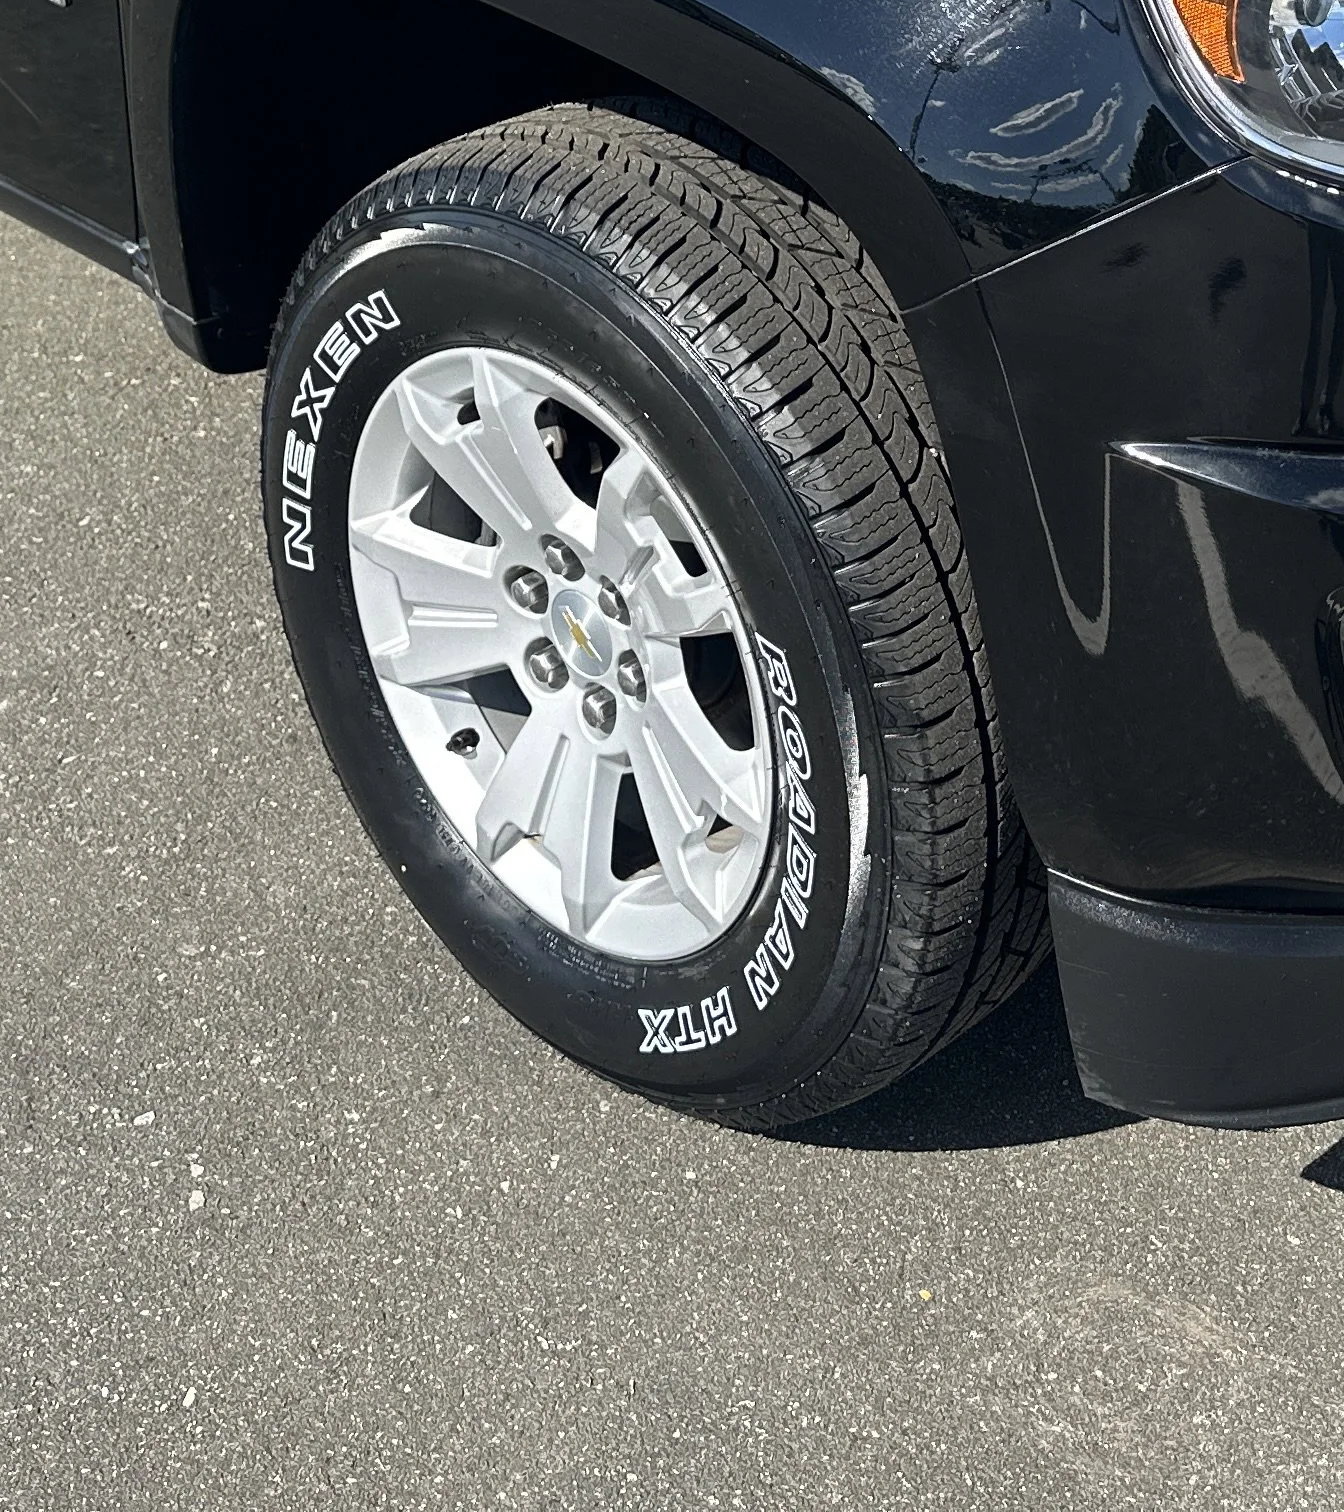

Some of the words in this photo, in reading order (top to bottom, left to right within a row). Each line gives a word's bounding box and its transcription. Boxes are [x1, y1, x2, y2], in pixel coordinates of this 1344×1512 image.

[282, 289, 401, 571] NEXEN
[743, 632, 816, 1010] ROADIAN
[637, 986, 738, 1054] HTX
